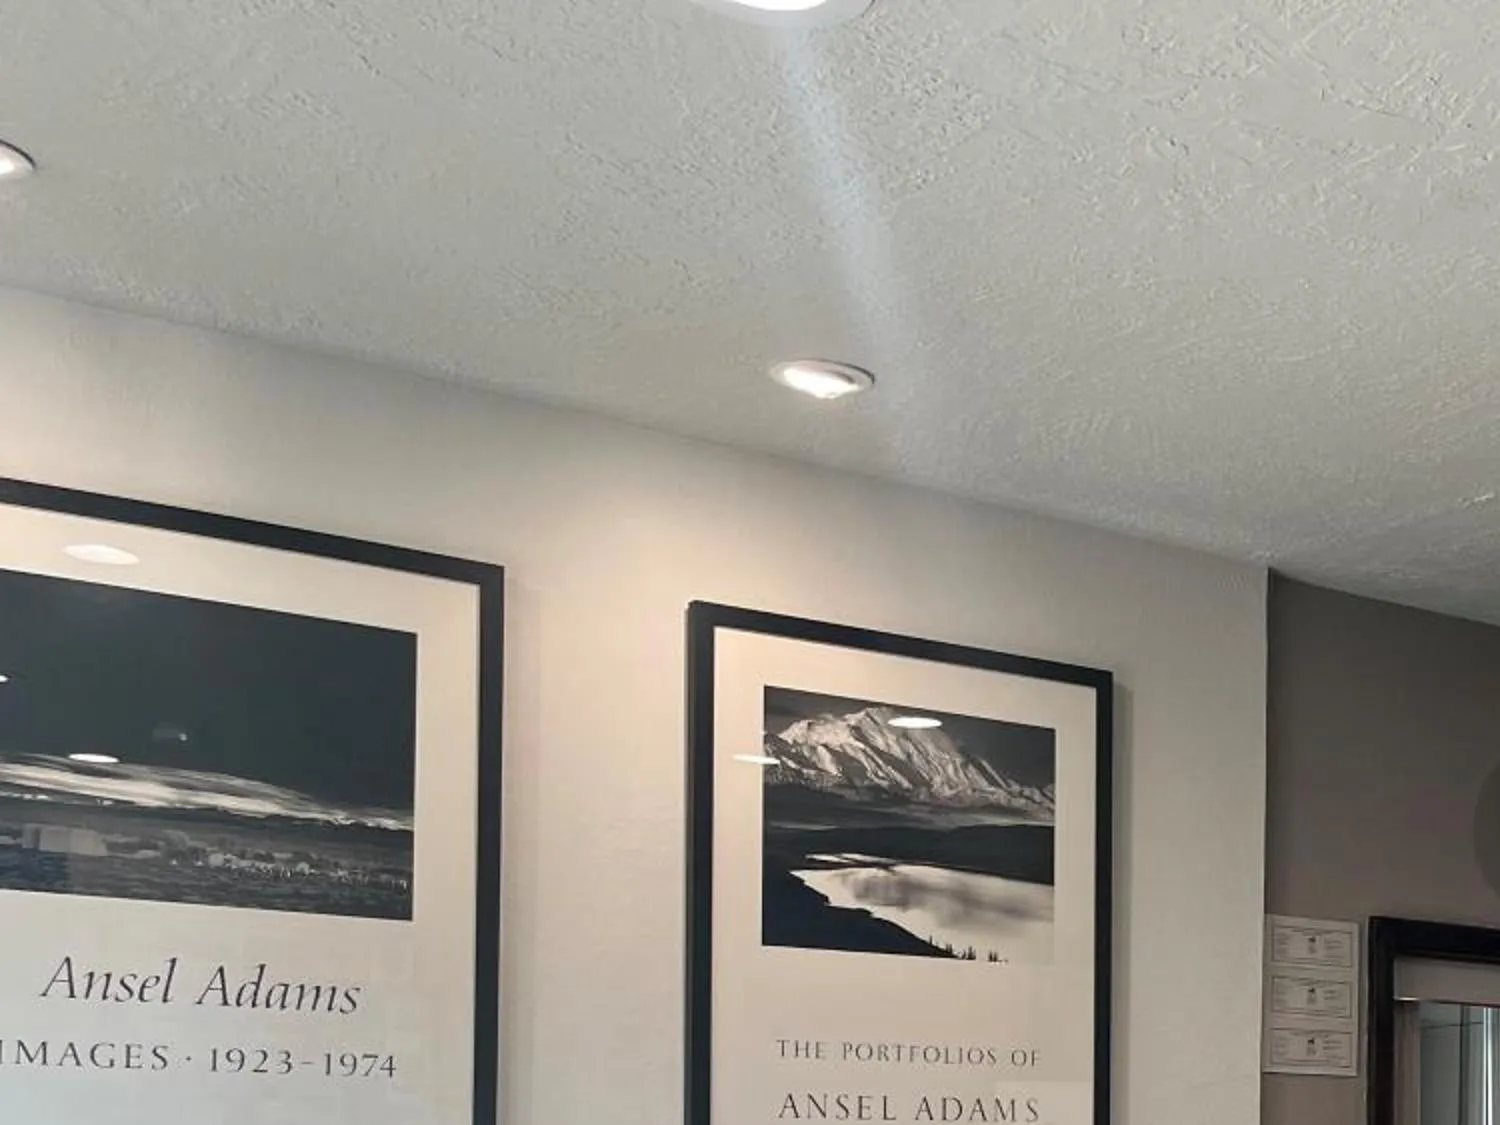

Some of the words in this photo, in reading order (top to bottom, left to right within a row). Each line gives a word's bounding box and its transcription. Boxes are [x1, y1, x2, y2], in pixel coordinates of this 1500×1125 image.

[40, 956, 178, 1003] Ansel
[196, 963, 361, 1015] Adams
[776, 1039, 825, 1060] THE
[842, 1042, 998, 1065] PORTFOLIOS
[1010, 1047, 1041, 1067] OF
[778, 1093, 897, 1121] ANSEL
[914, 1096, 1040, 1123] ADAMS
